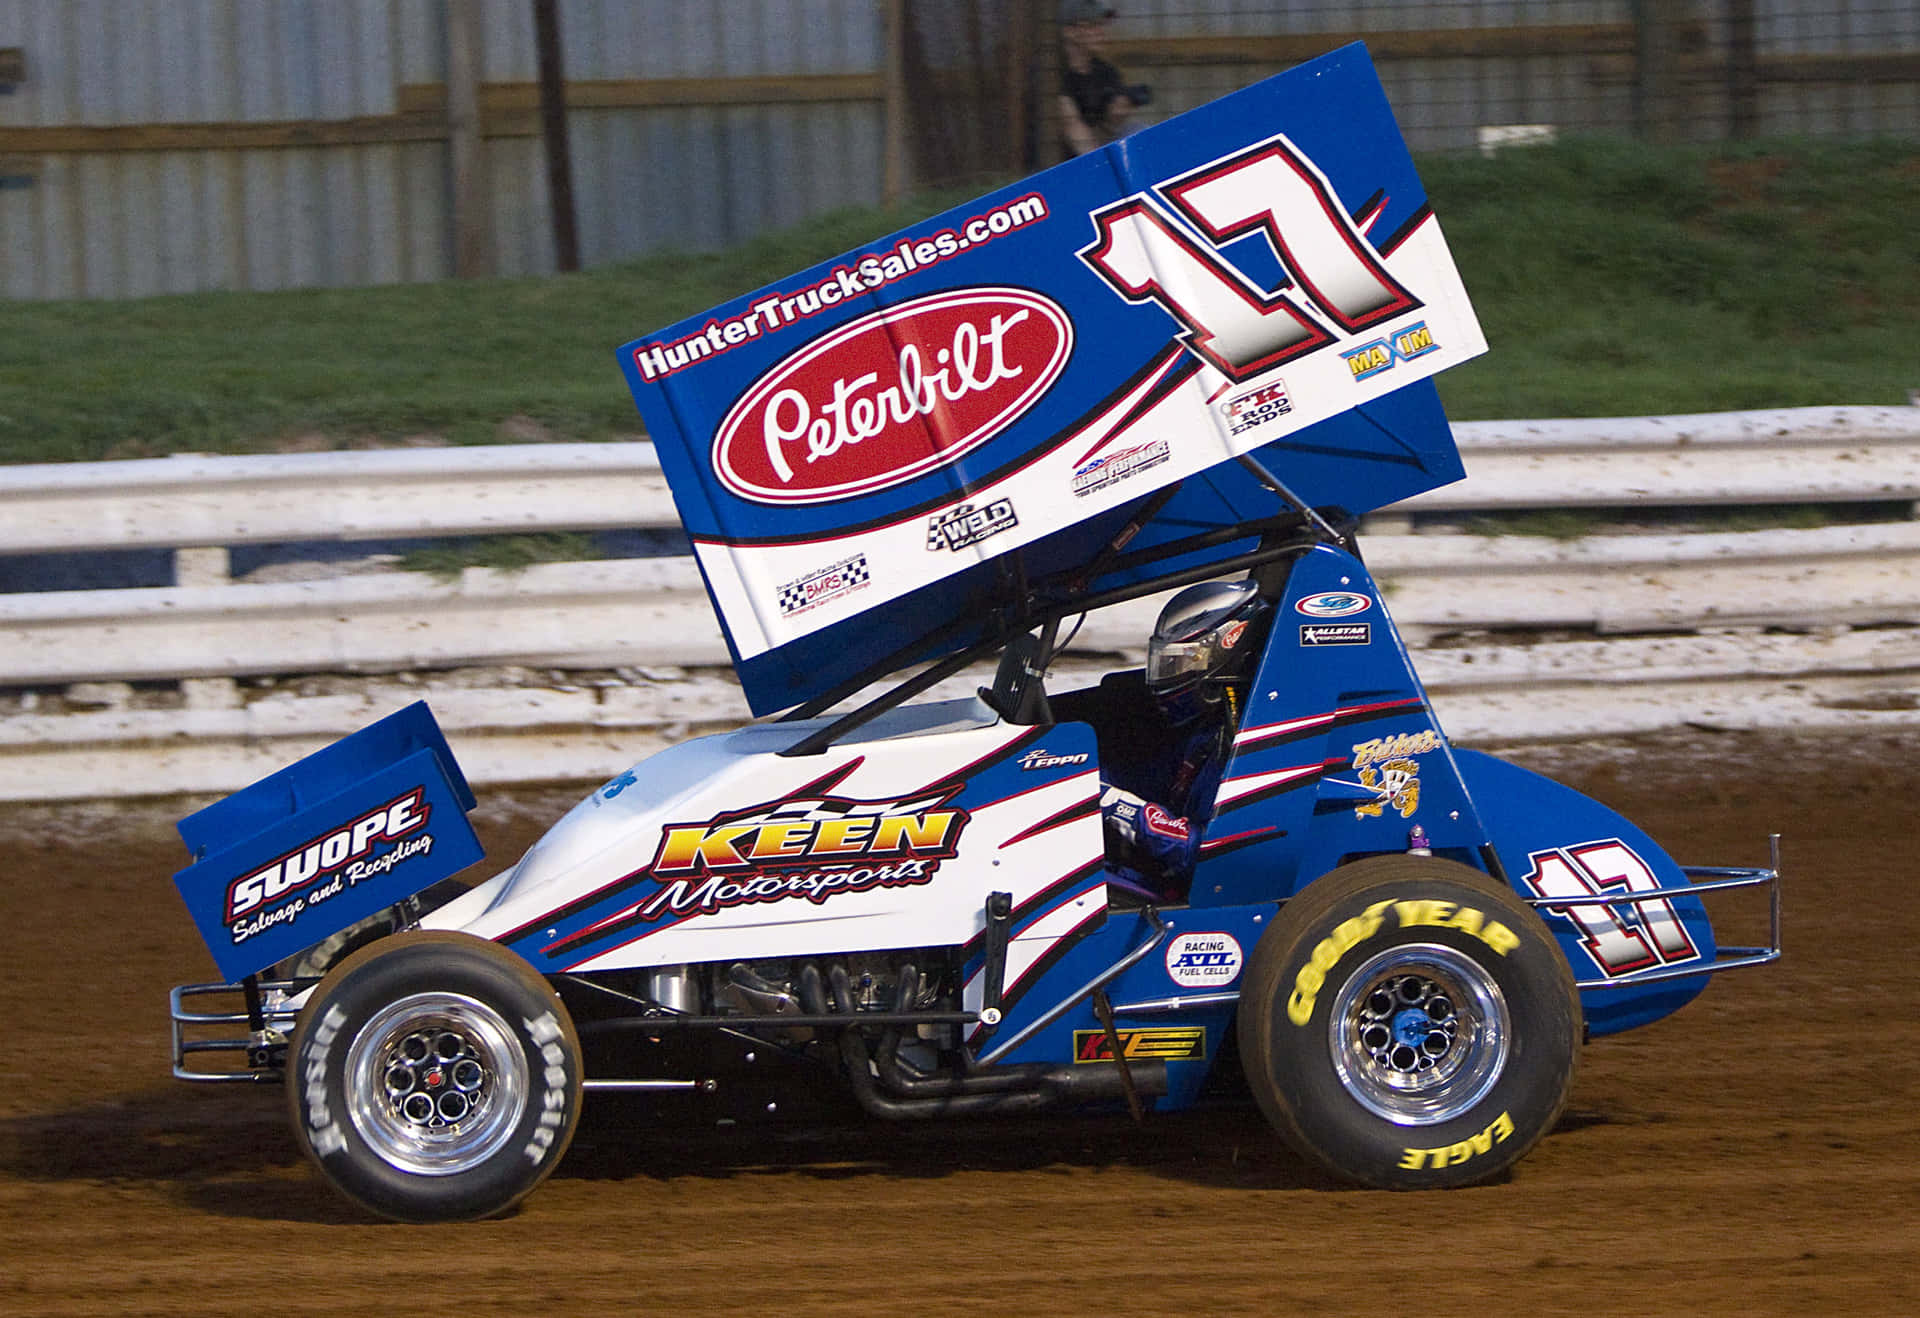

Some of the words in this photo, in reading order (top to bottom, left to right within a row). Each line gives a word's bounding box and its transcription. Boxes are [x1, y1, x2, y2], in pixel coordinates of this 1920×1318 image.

[1074, 132, 1425, 385] 17
[636, 193, 1048, 382] HunterTruckSales.com
[1344, 326, 1434, 377] MAXIM
[763, 307, 1031, 484] Peterbilt
[1230, 382, 1286, 417] FK
[1230, 405, 1293, 436] ENDS
[1241, 397, 1289, 422] ROD
[943, 501, 1013, 541] WELD
[953, 518, 1016, 550] RACING
[805, 574, 842, 600] BMRS
[1316, 627, 1367, 635] ALLSTAR
[229, 793, 427, 918] SWOPE
[652, 811, 956, 874] KEEN
[232, 896, 305, 944] Salvage
[308, 873, 343, 904] and
[345, 834, 433, 885] Recycling
[641, 858, 932, 916] Motorsports
[1520, 836, 1702, 979] 17
[1170, 952, 1237, 968] ATL
[1178, 968, 1201, 977] FUEL
[1203, 967, 1230, 976] CELLS
[1184, 941, 1225, 952] RACING
[1287, 897, 1521, 1027] GOODYEAR
[1397, 1111, 1516, 1171] EAGLE
